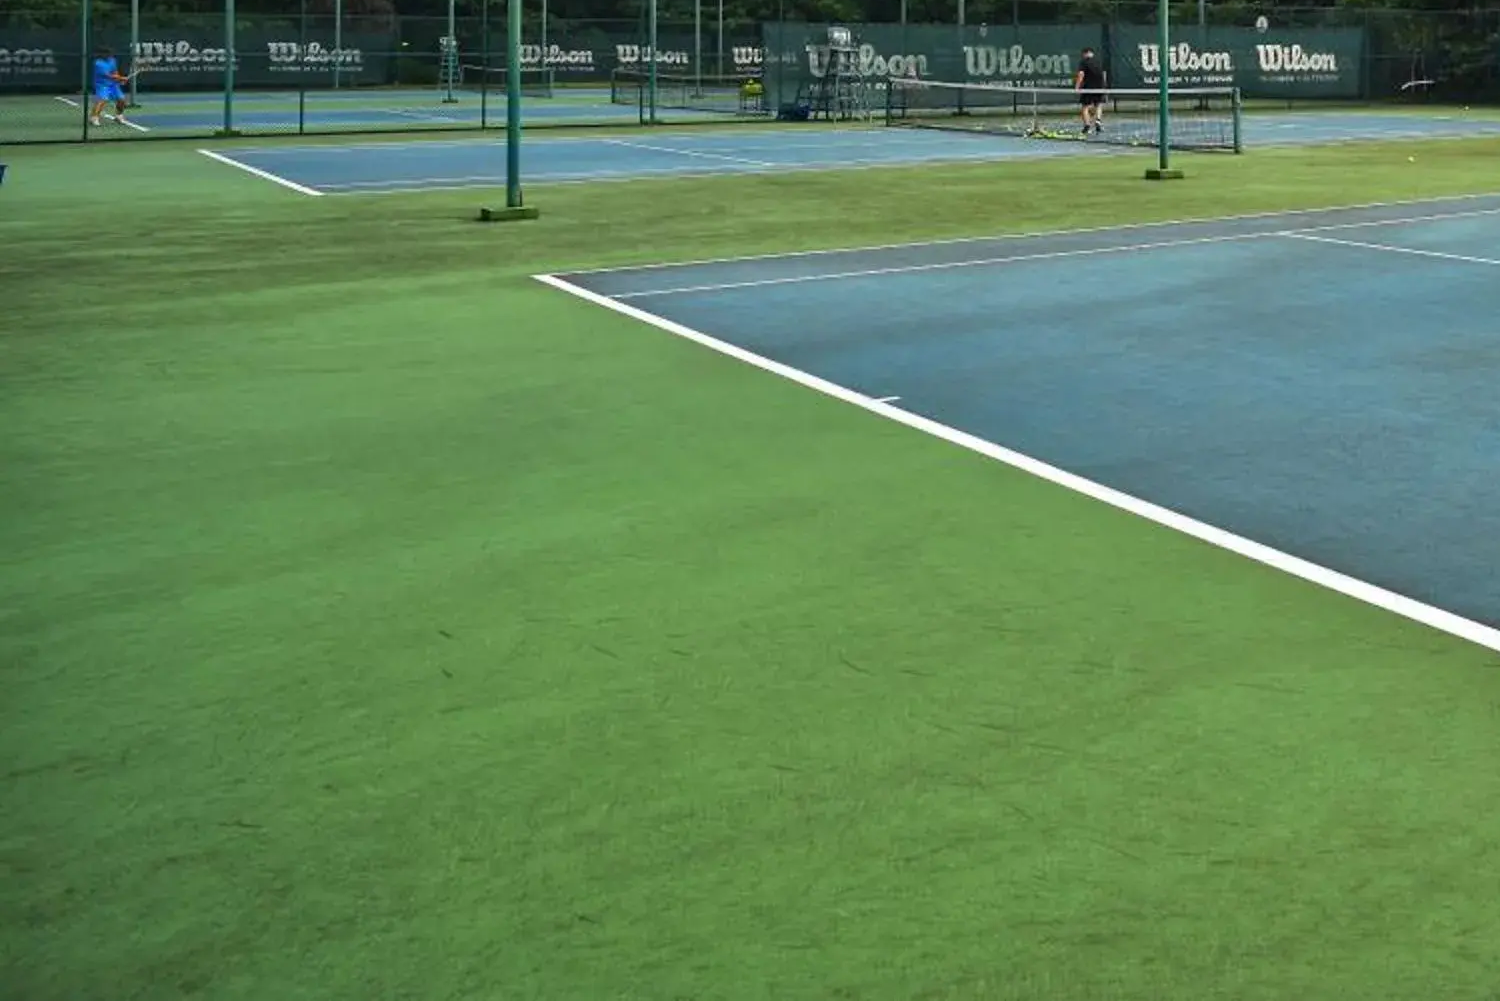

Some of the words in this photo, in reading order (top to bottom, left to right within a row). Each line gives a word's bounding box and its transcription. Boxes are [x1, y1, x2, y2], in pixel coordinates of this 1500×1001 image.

[267, 42, 363, 63] Wilson
[963, 44, 1073, 76] Wilson
[1255, 43, 1339, 72] Wilson
